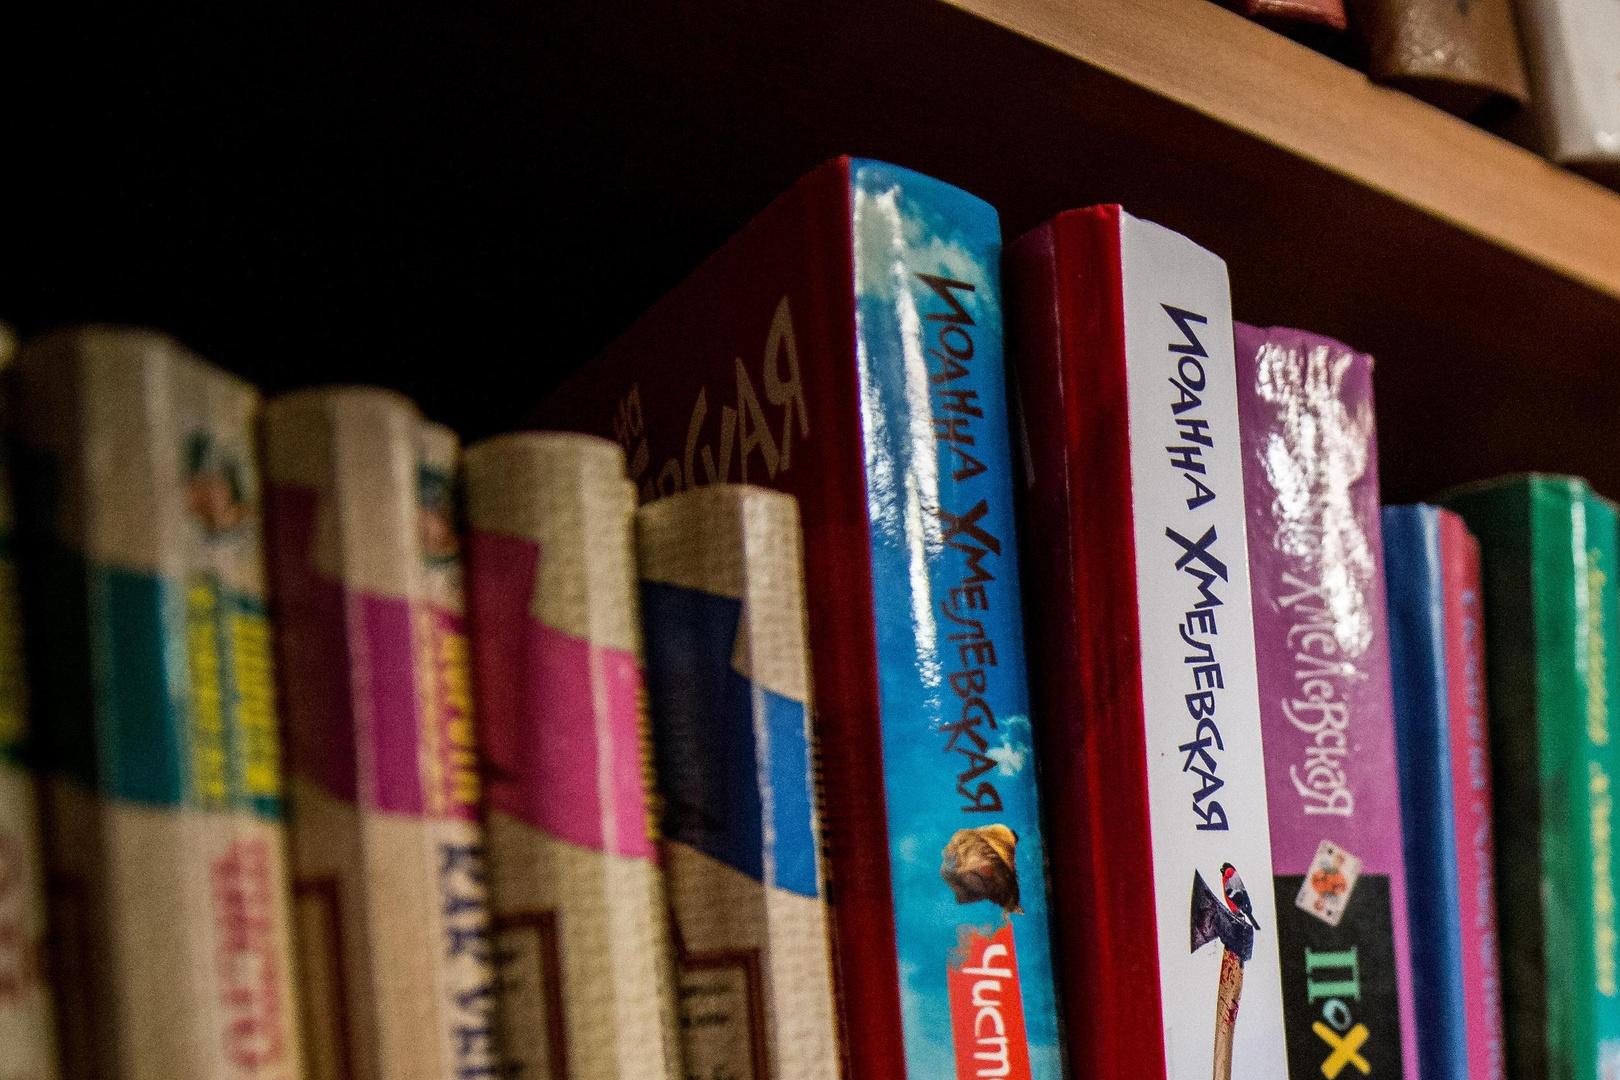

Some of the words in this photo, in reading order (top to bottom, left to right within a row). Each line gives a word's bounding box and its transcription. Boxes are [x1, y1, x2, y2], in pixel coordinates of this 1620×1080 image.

[914, 272, 988, 483] ИОАННА
[1161, 302, 1216, 513] ИОАННА
[936, 498, 1004, 815] ХМЕЛЕВСКАЯ
[1165, 525, 1231, 832] ХМЕЛЕВСКАЯ
